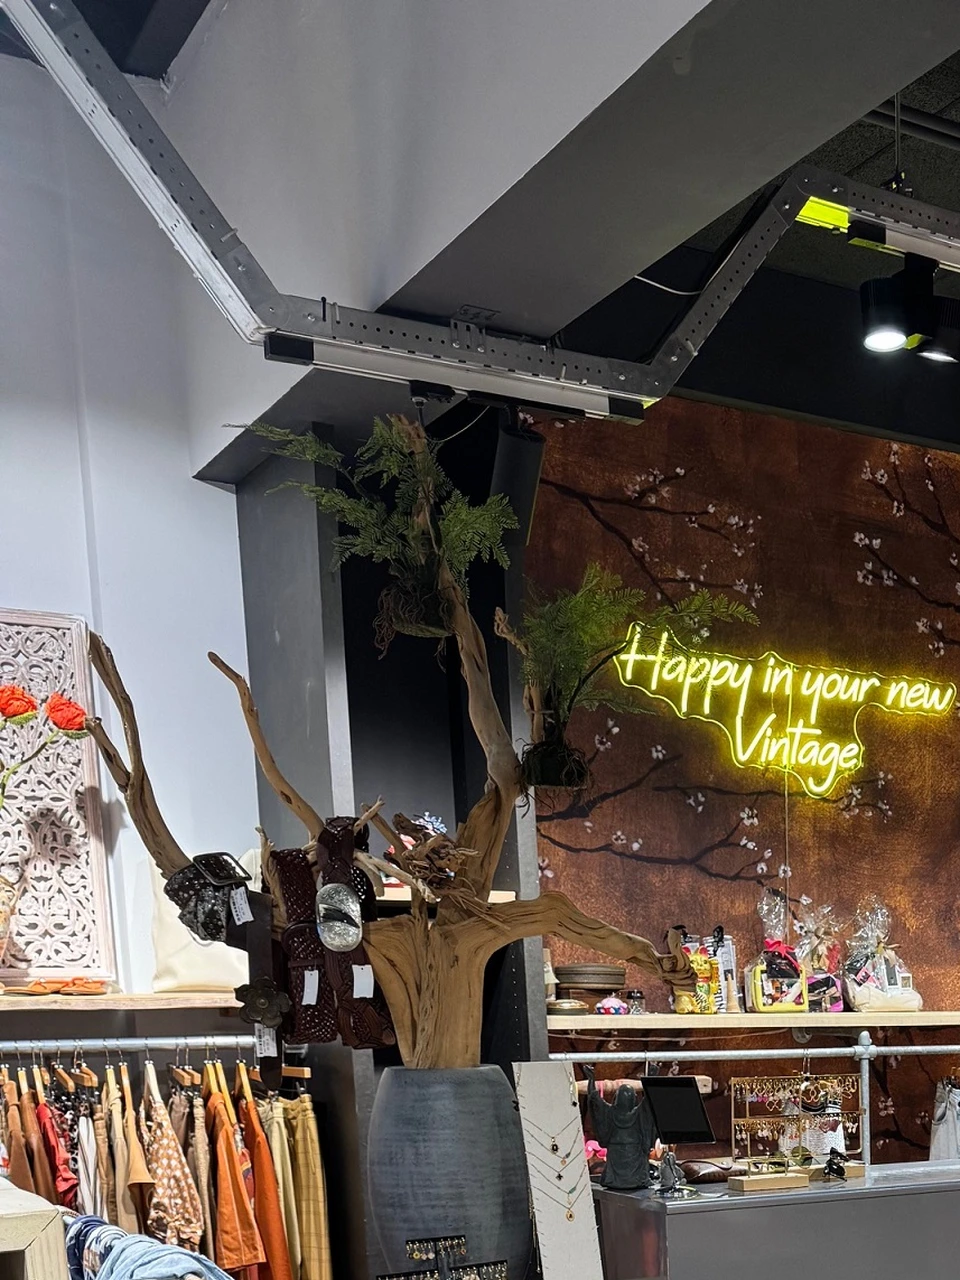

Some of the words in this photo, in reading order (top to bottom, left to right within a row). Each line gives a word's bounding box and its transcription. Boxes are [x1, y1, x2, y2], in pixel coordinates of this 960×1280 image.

[620, 626, 752, 716] Happy
[763, 657, 791, 694] in
[800, 670, 881, 724] your
[886, 683, 953, 710] new
[735, 713, 859, 793] Vintage
